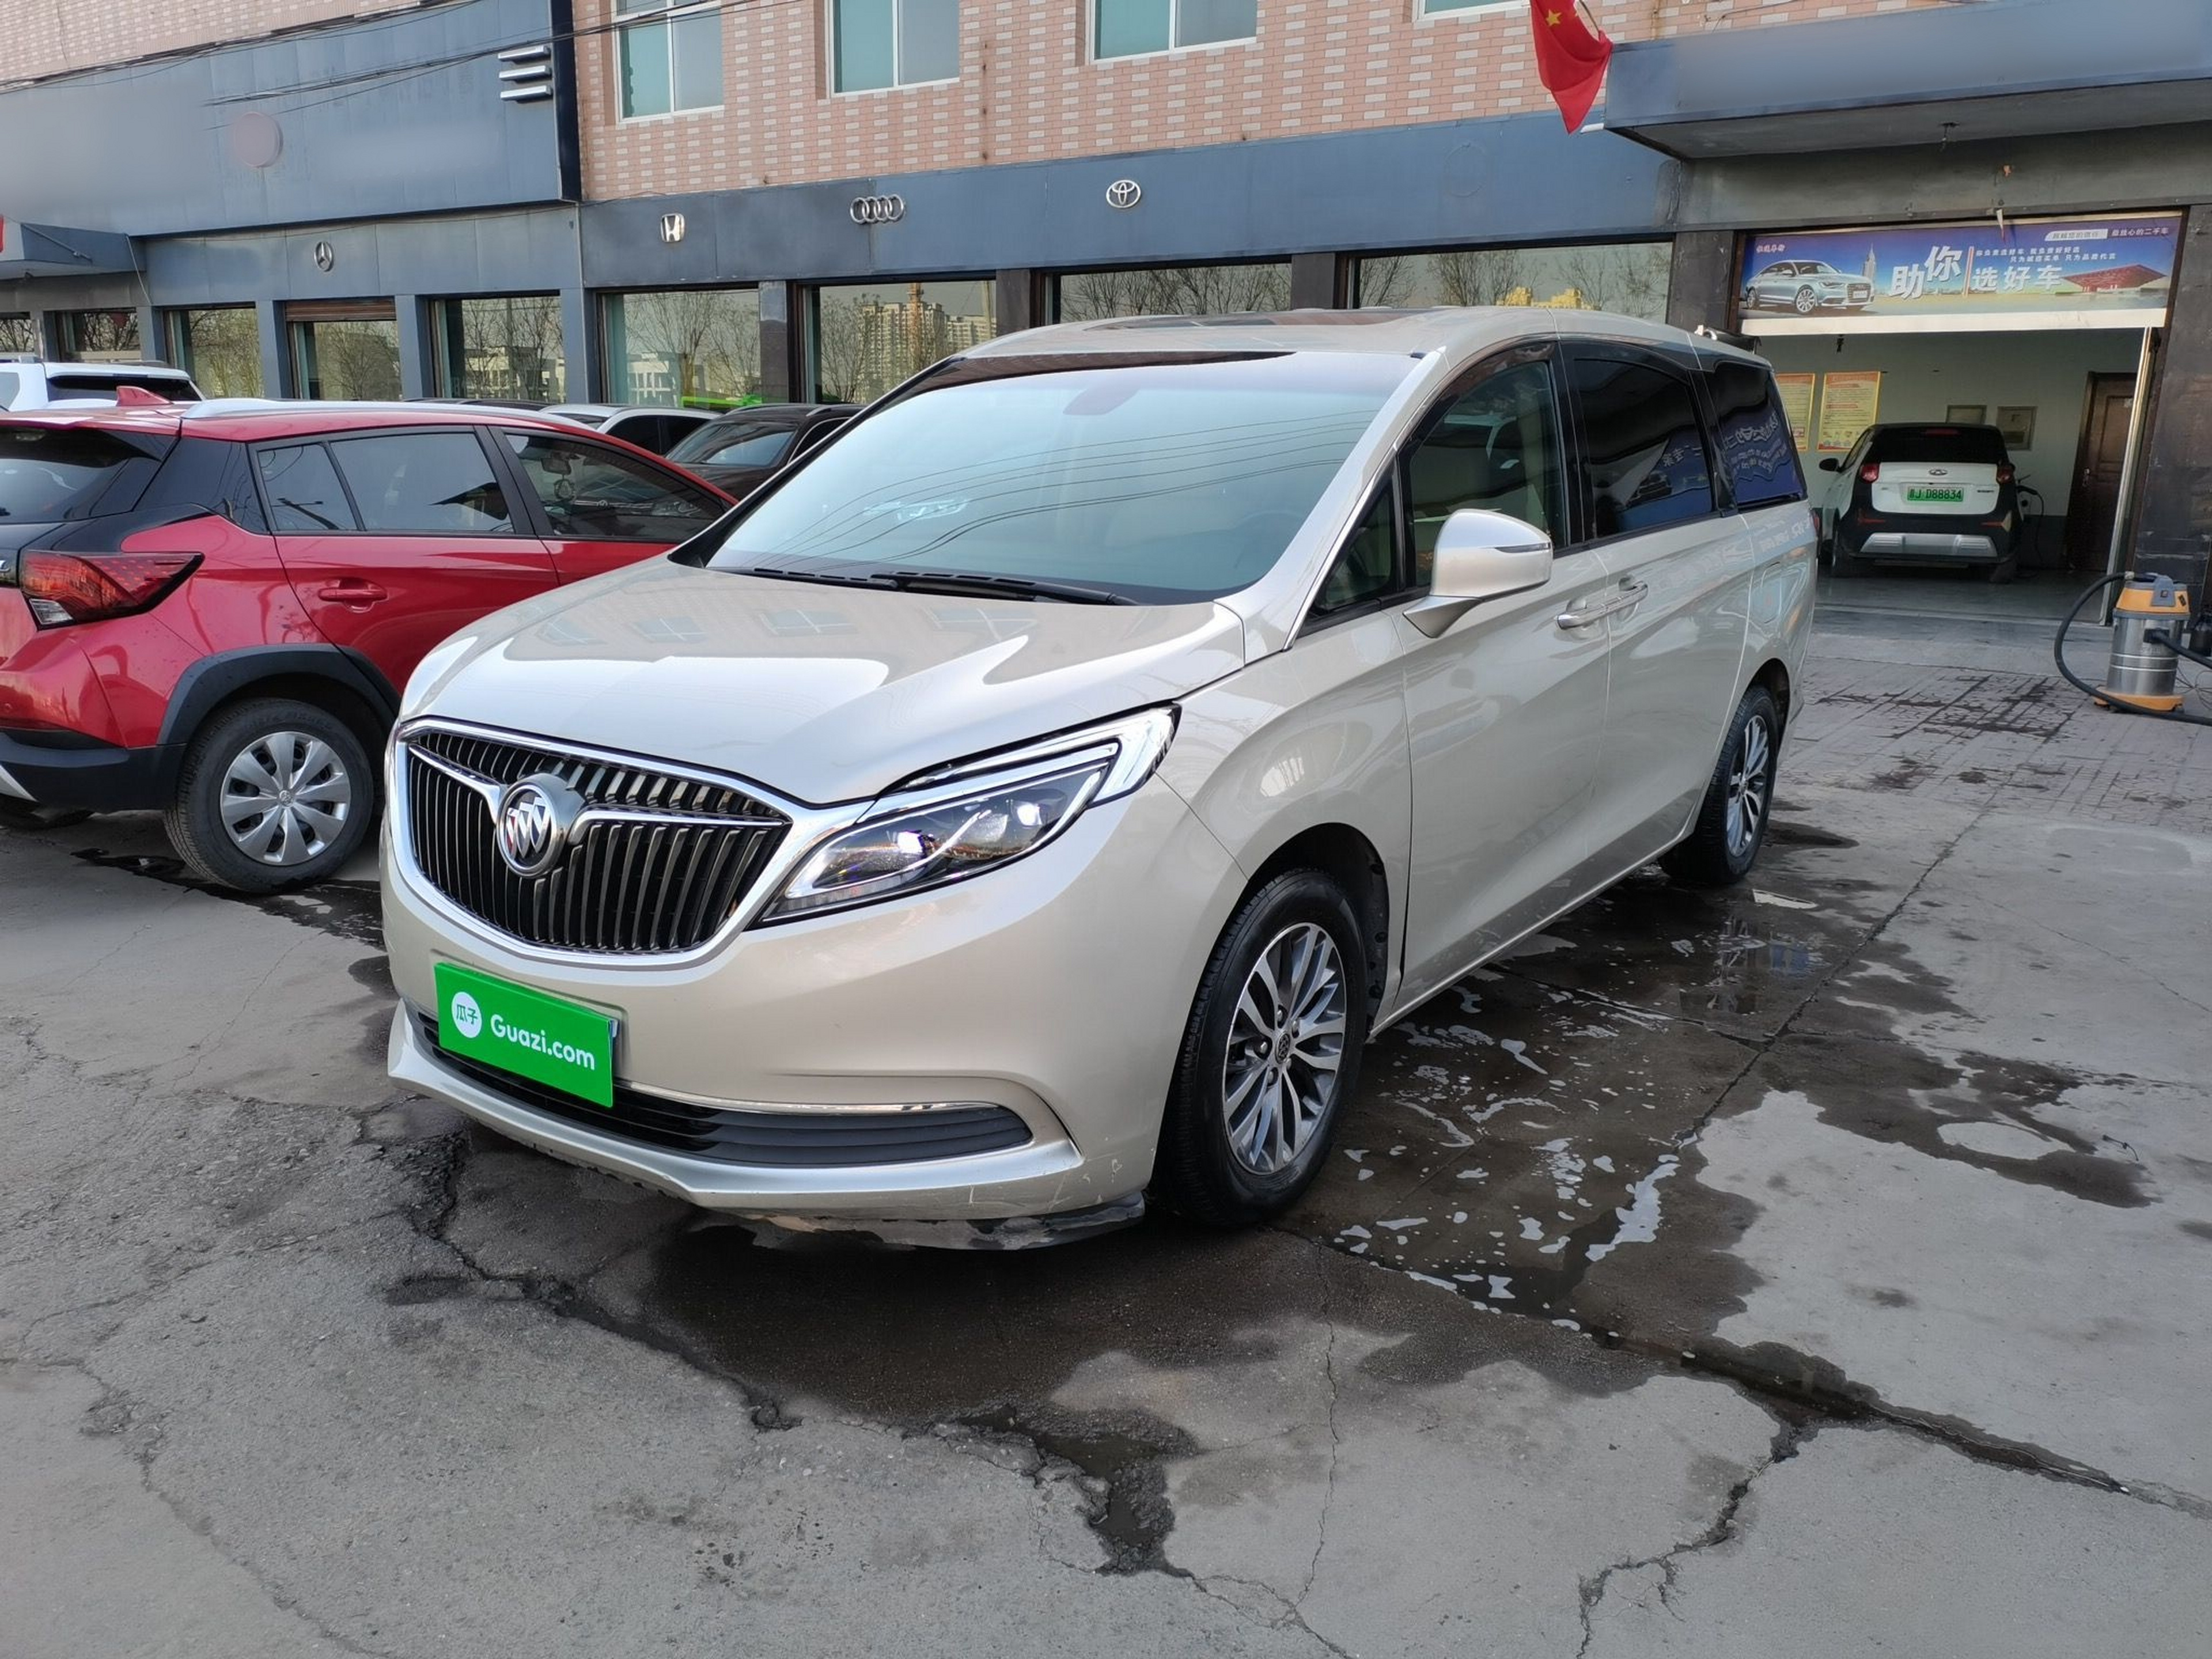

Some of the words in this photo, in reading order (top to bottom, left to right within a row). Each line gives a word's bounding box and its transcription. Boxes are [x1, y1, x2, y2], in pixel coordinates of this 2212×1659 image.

[1888, 245, 1963, 300] 助你
[1969, 265, 2062, 292] 选好车
[456, 1003, 479, 1025] 瓜子
[490, 1014, 595, 1070] Guazi.com
